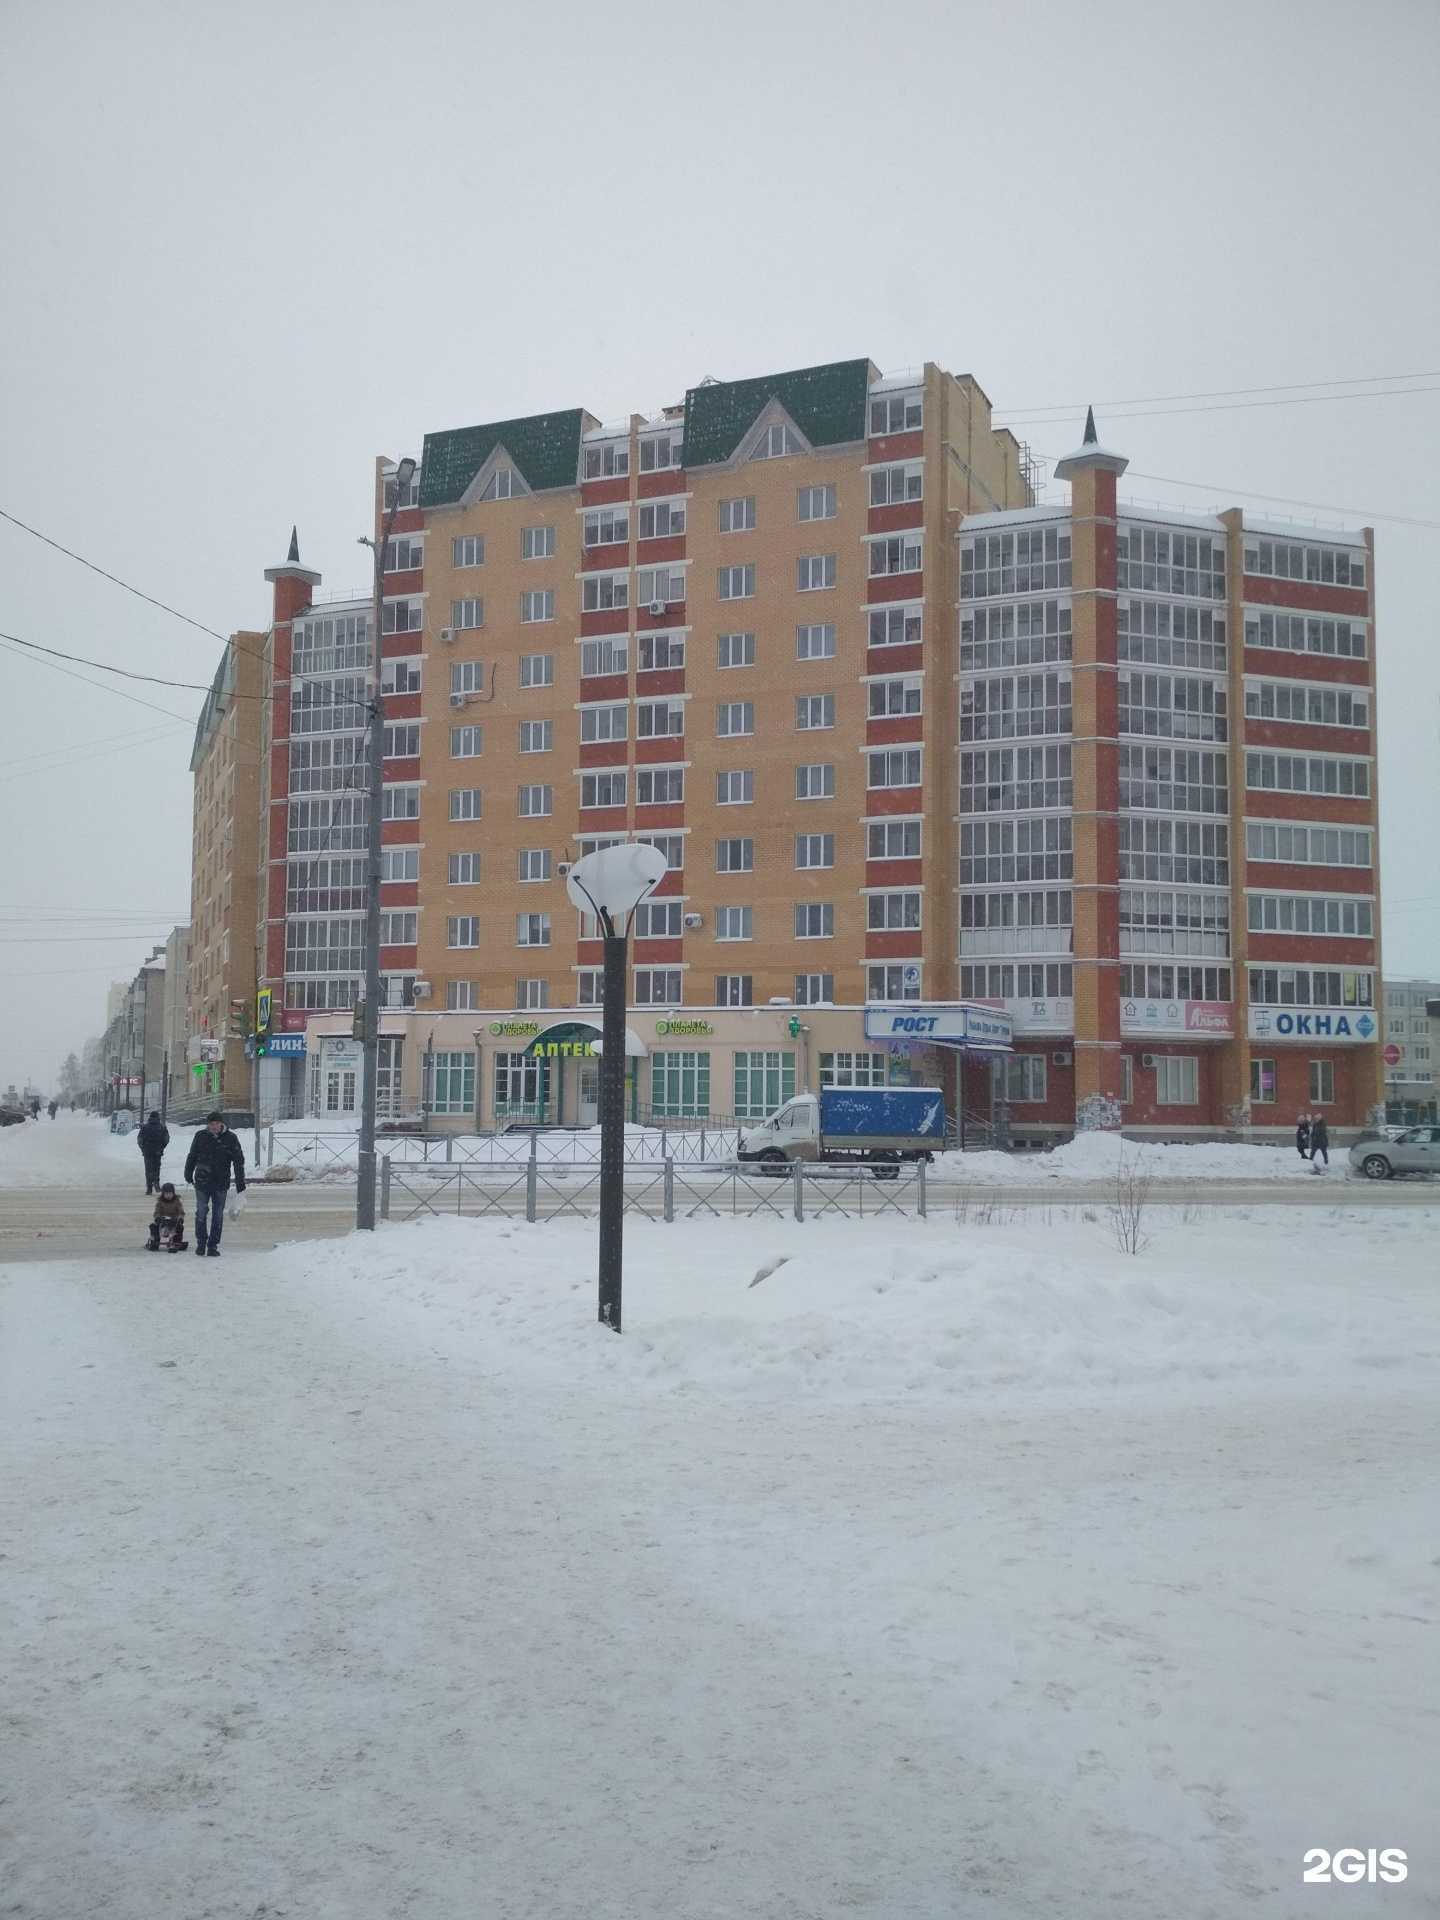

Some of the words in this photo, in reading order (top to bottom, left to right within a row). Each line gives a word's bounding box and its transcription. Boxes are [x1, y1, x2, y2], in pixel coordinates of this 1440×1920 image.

[891, 1017, 939, 1032] РОСТ
[1276, 1013, 1351, 1035] ОКНА
[270, 1040, 308, 1051] ЛИНЗ
[533, 1043, 597, 1056] АПТЕК
